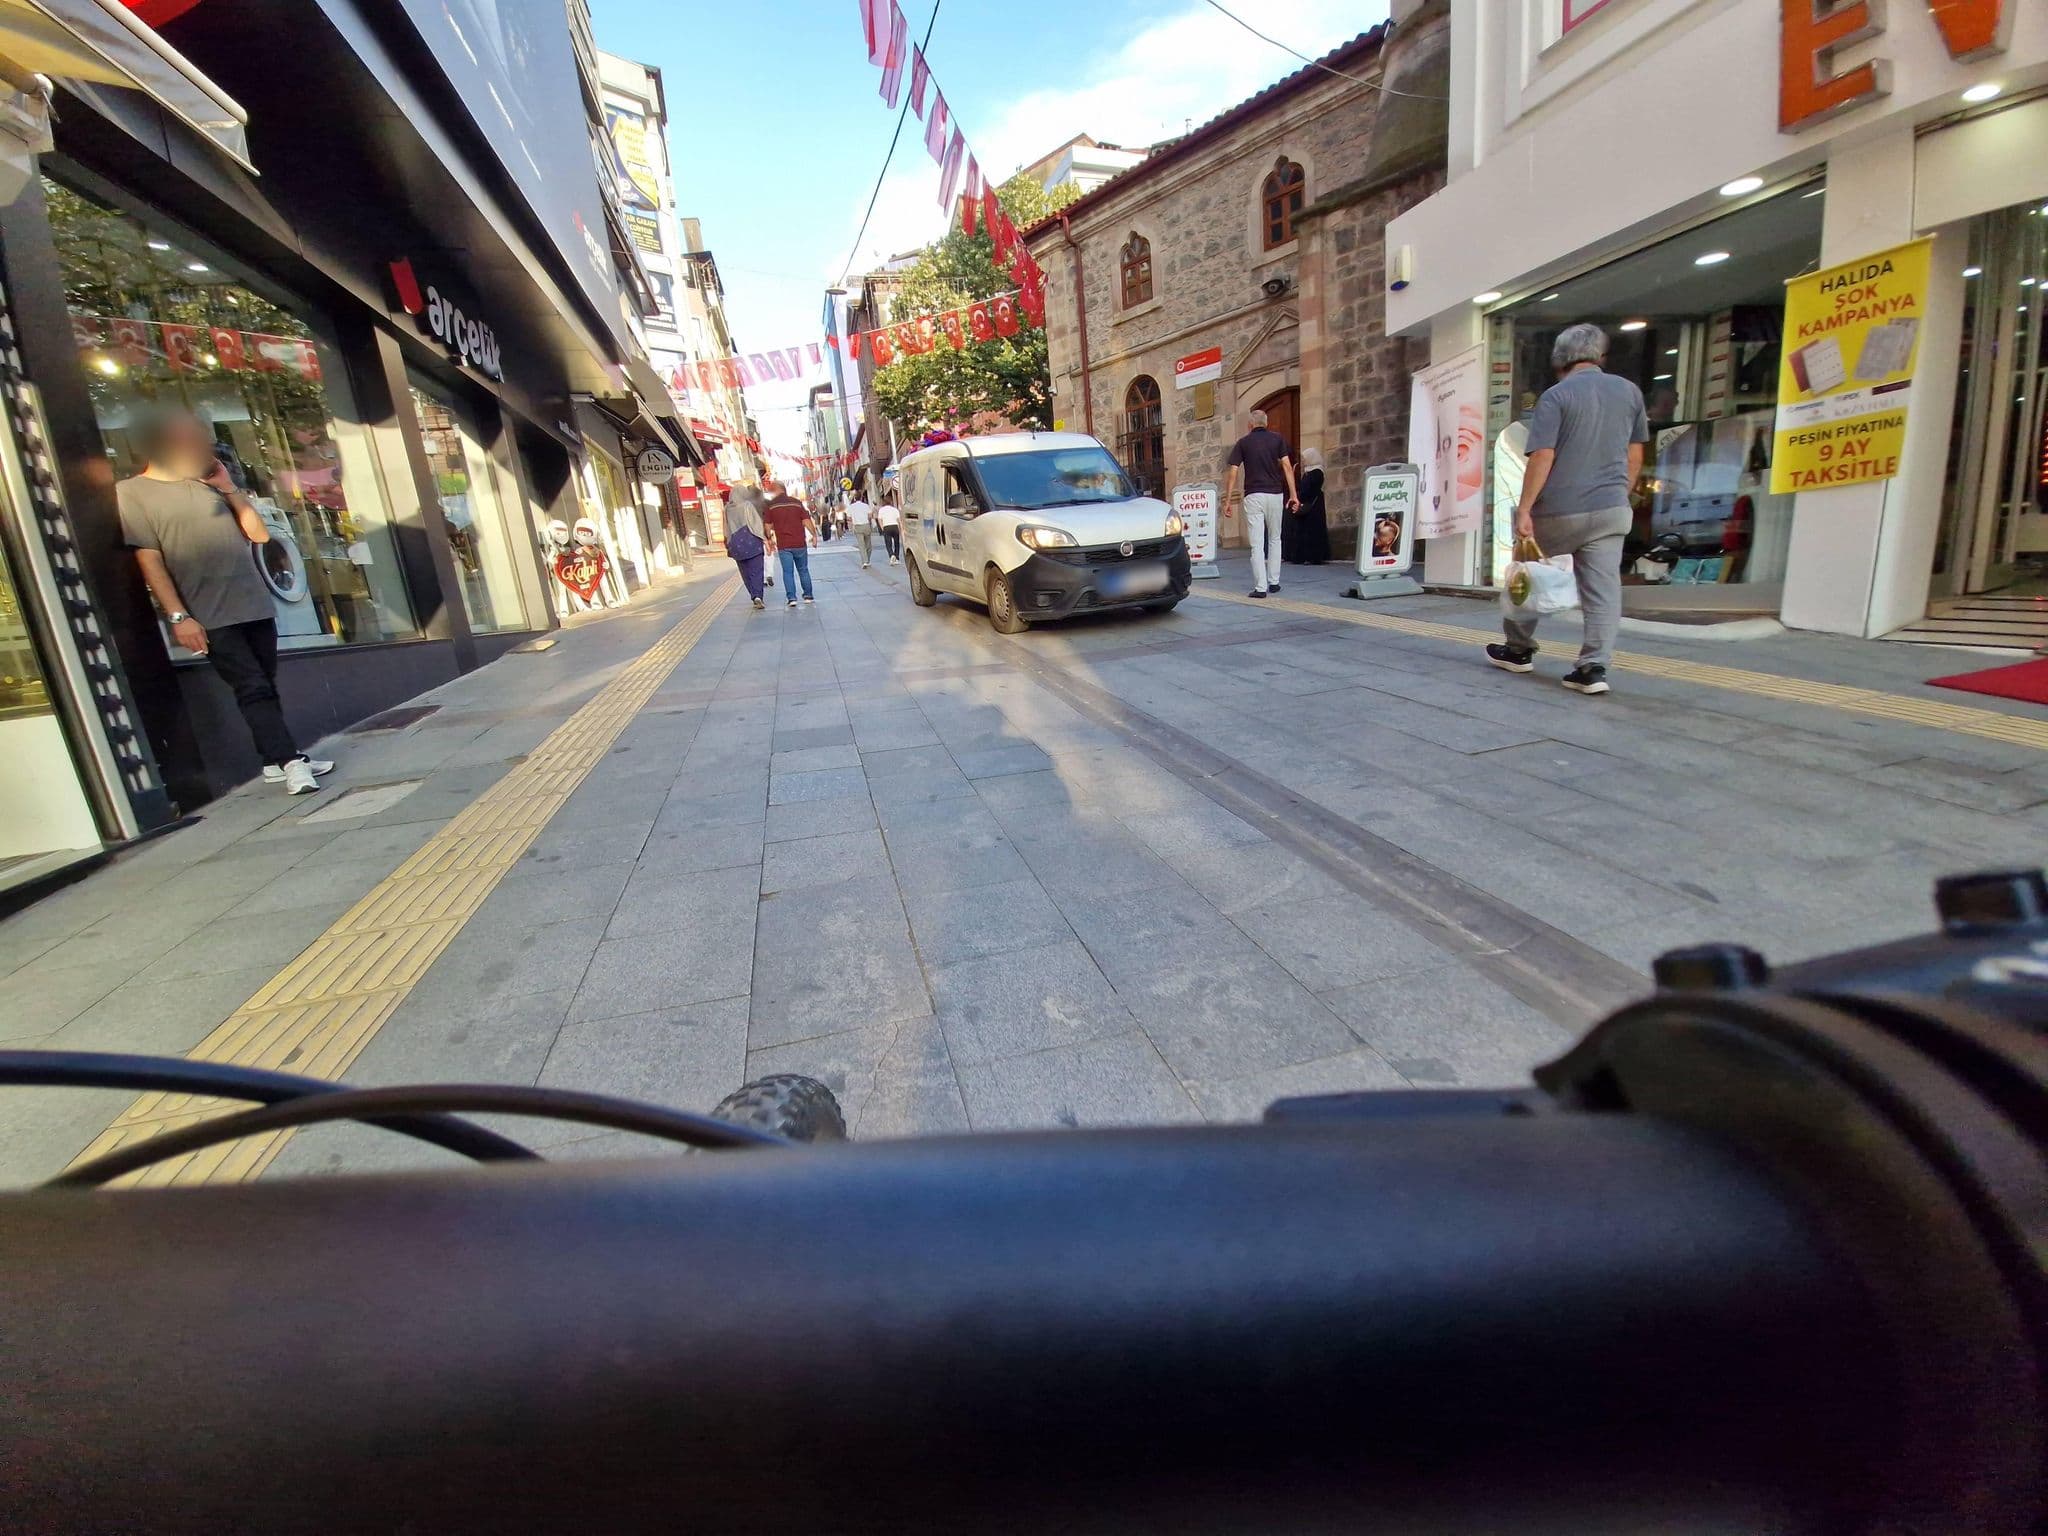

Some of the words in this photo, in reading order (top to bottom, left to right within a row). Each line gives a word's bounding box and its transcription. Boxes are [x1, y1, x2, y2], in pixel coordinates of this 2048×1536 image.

[1820, 259, 1894, 295] HALIDA
[1835, 282, 1880, 311] ŞOK
[1798, 292, 1915, 338] KAMPANYA
[1836, 415, 1904, 438] FİYATINA
[1819, 444, 1833, 462] 9
[1840, 437, 1871, 459] AY
[1789, 455, 1897, 487] TAKSİTLE
